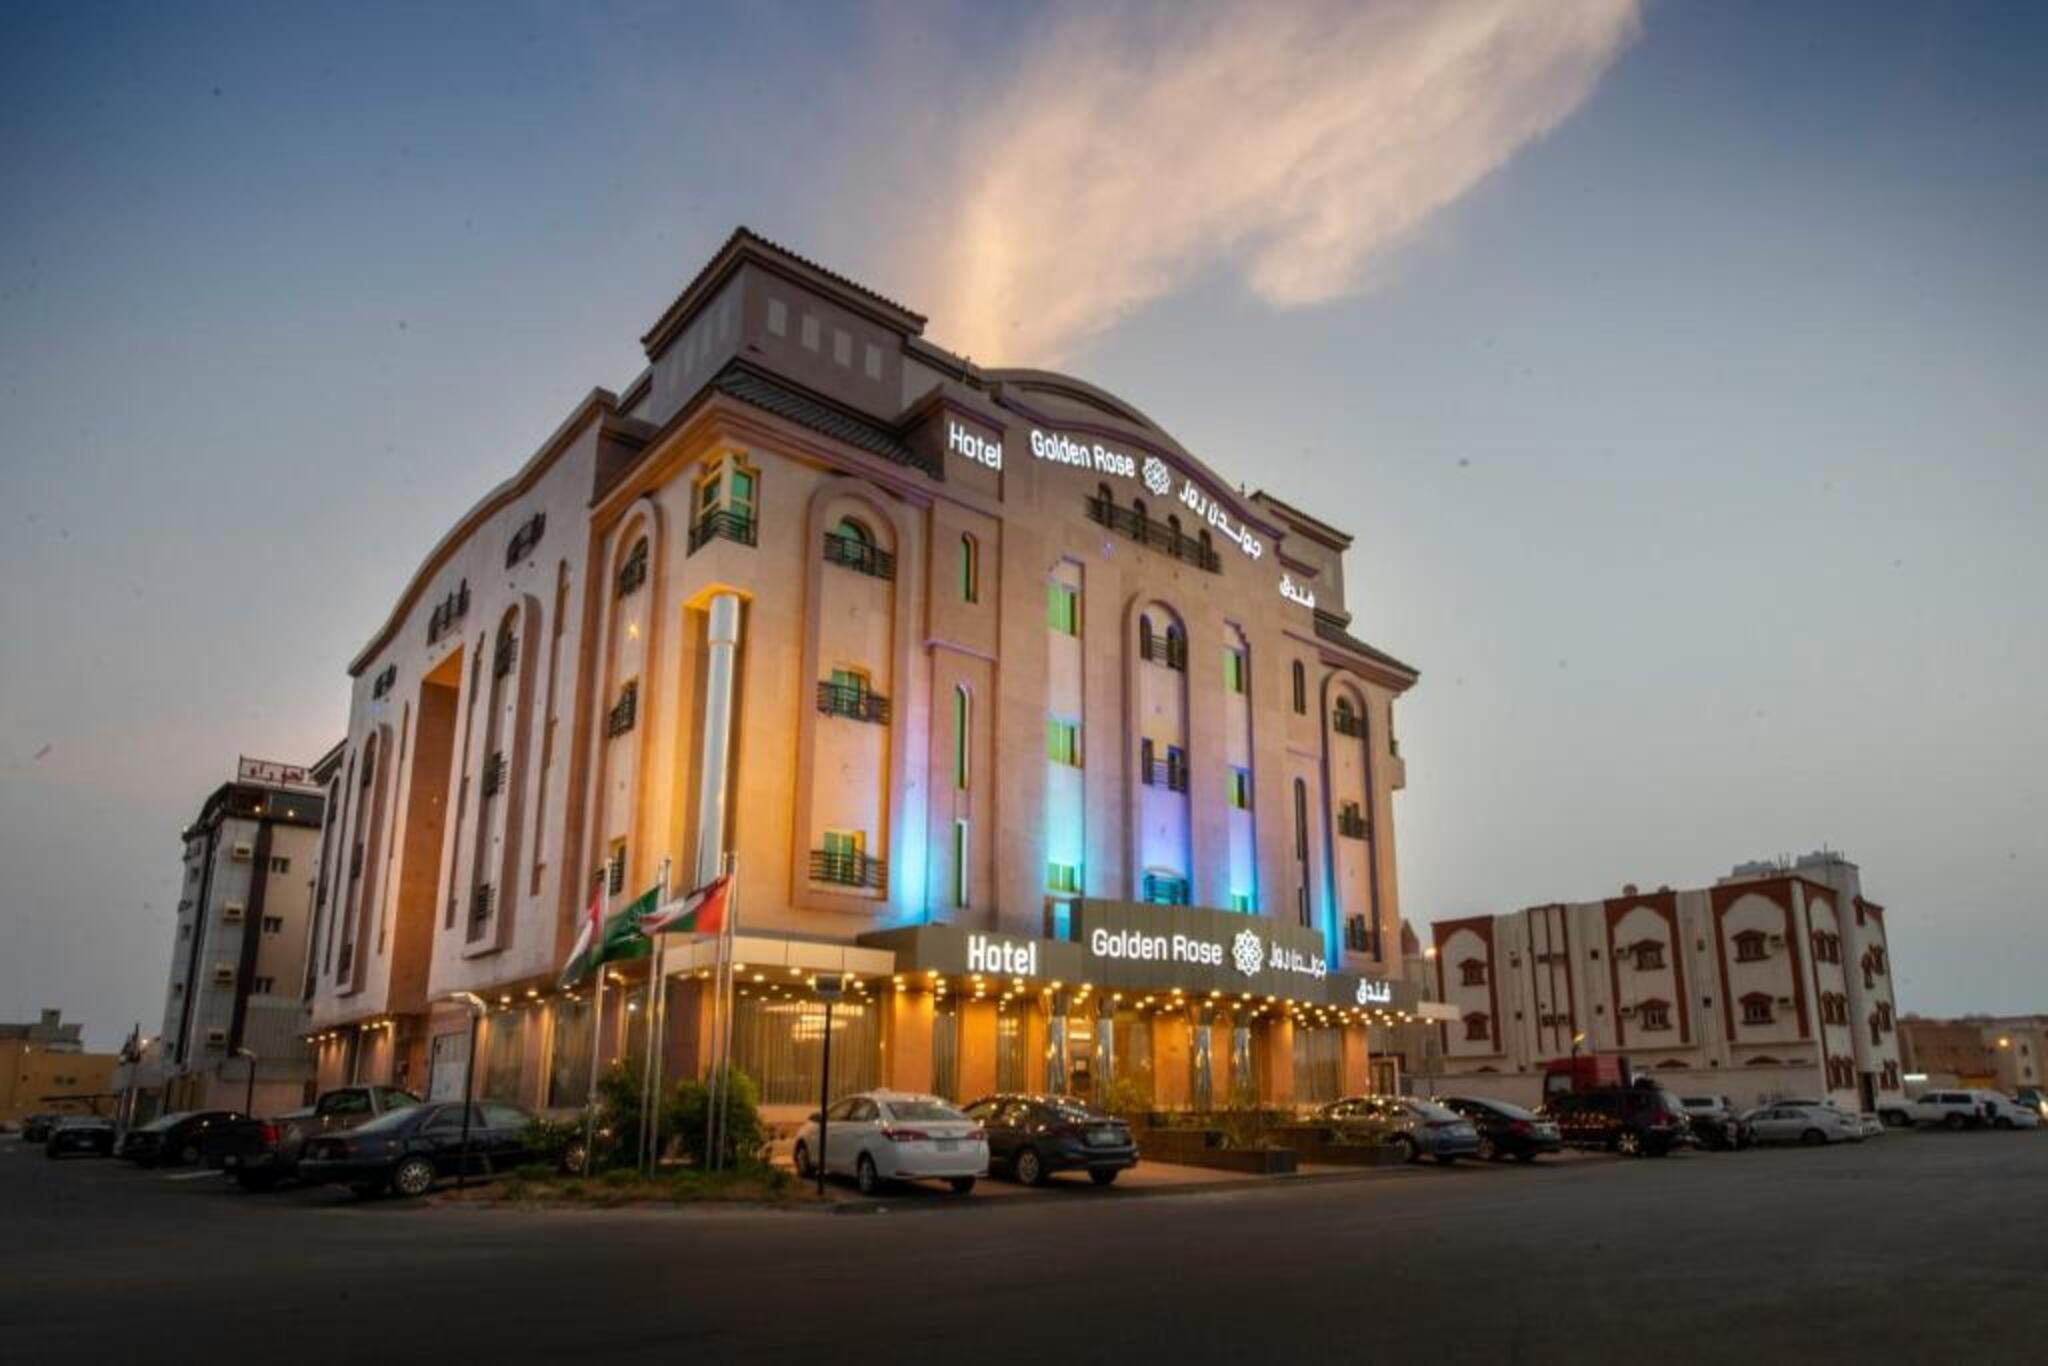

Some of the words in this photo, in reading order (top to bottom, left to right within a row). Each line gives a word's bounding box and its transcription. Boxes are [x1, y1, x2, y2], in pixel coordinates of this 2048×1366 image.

[949, 421, 1003, 471] Hotel
[1031, 429, 1092, 468] Golden
[1093, 445, 1135, 478] Rose
[967, 934, 1036, 976] Hotel
[1091, 928, 1167, 960] Golden
[1172, 934, 1223, 965] Rose
[1356, 977, 1391, 1005] فندق
